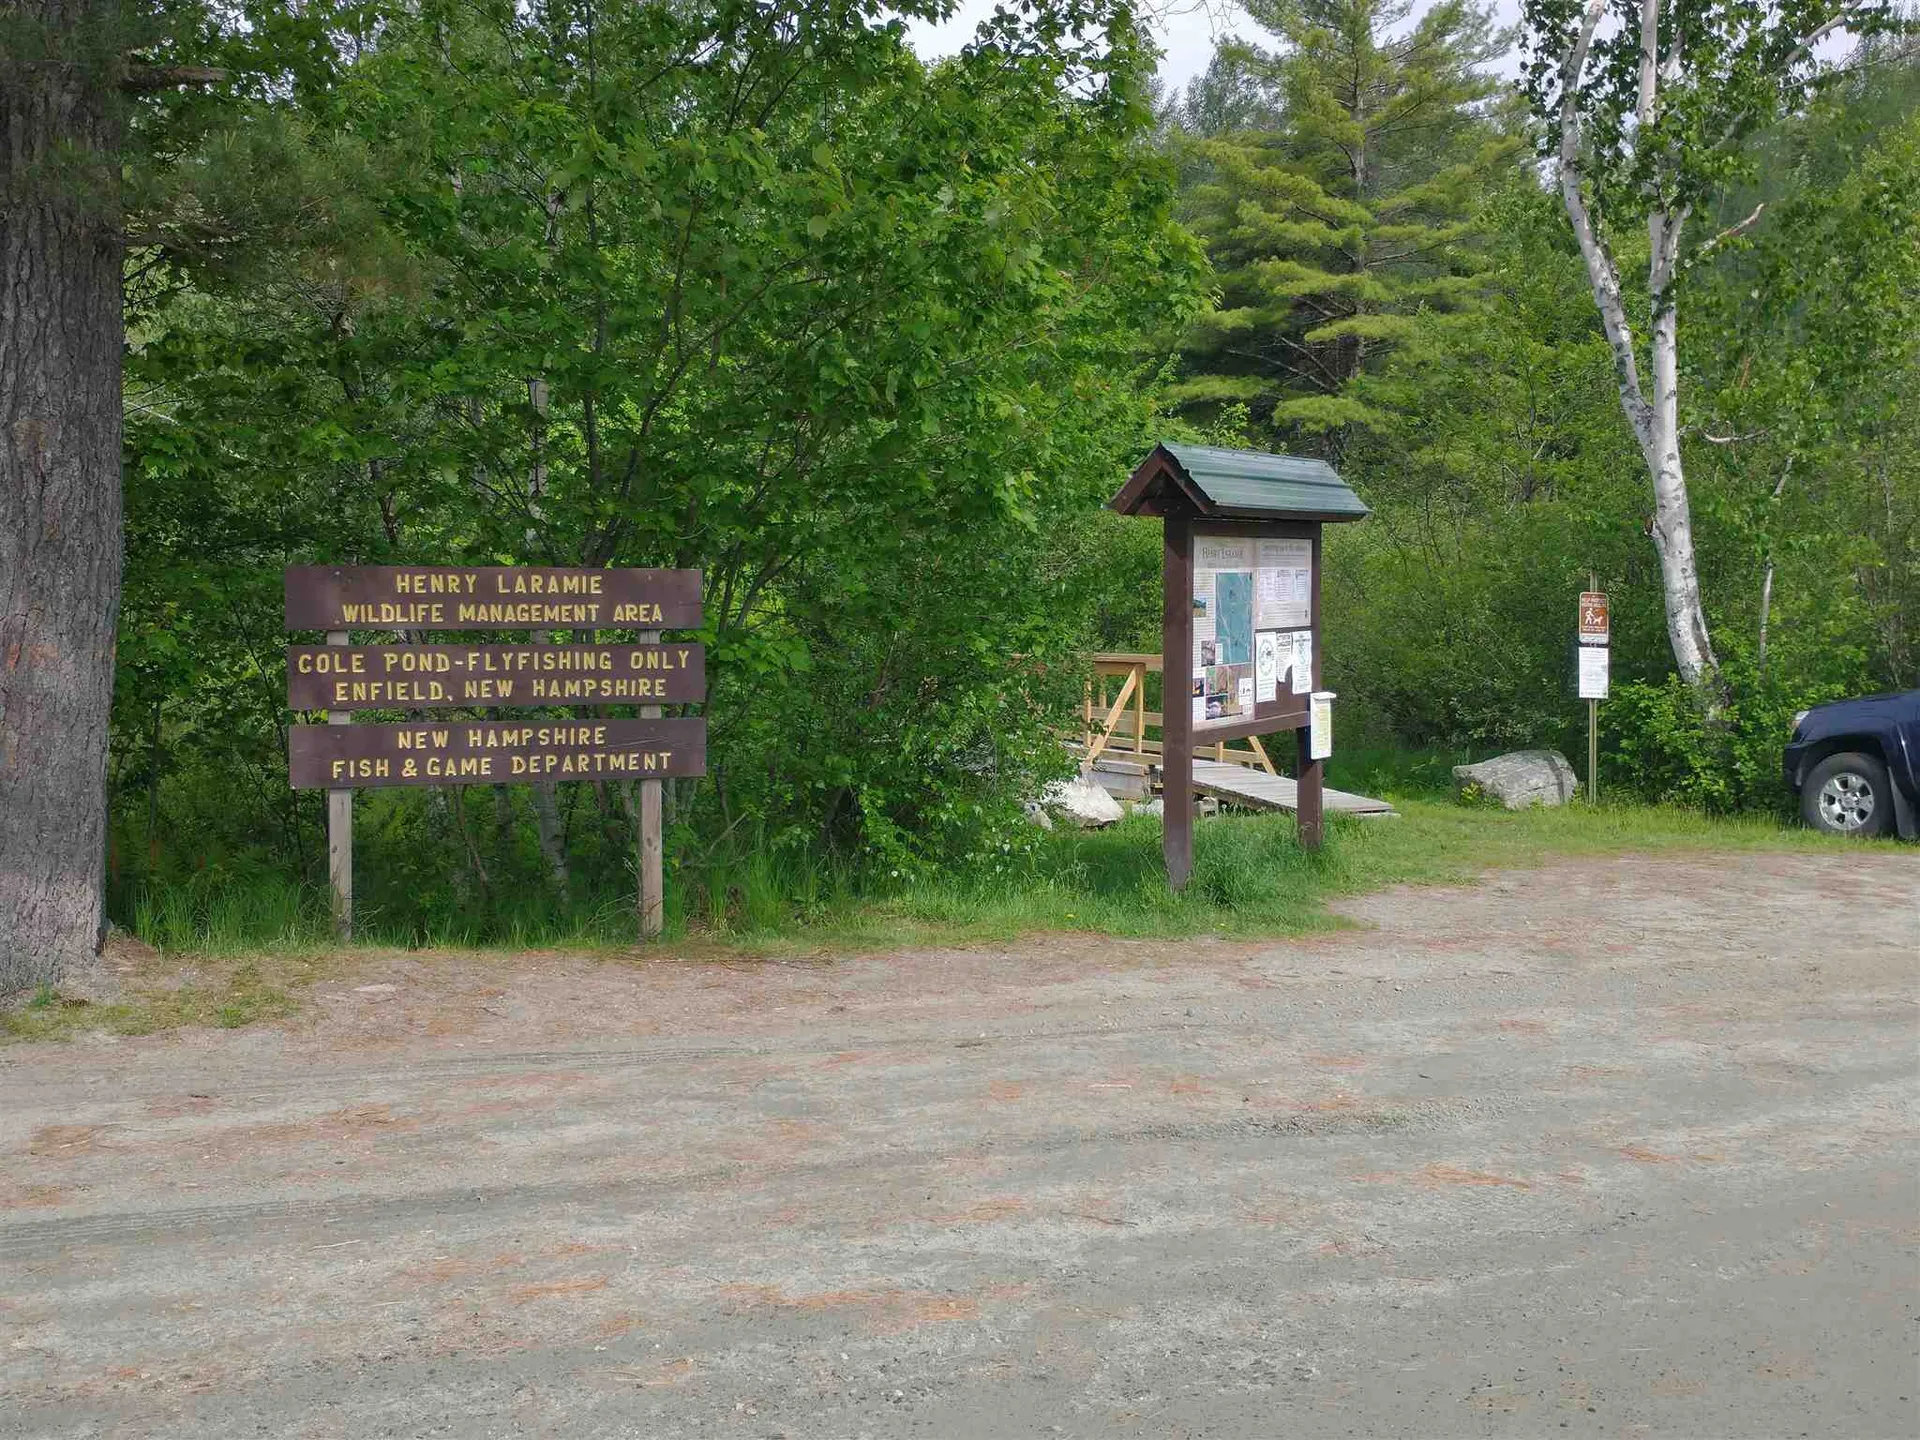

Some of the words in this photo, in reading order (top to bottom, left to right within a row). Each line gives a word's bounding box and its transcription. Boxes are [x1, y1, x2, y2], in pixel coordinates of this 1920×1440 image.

[396, 574, 477, 594] HENRY
[498, 574, 603, 594] LARAMIE
[342, 604, 444, 624] WILDLIFE
[459, 604, 600, 623] MANAGEMENT
[613, 603, 663, 622] AREA
[298, 653, 364, 674] COLE
[384, 651, 612, 674] POND-FLYFISHING
[630, 650, 690, 670] ONLY
[335, 682, 453, 702] ENFIELD,
[465, 679, 513, 699] NEW
[532, 678, 667, 698] HAMPSHIRE
[397, 731, 449, 750] NEW
[468, 726, 606, 748] HAMPSHIRE
[332, 759, 390, 779] FISH
[426, 757, 493, 776] GAME
[511, 751, 673, 774] DEPARTMENT
